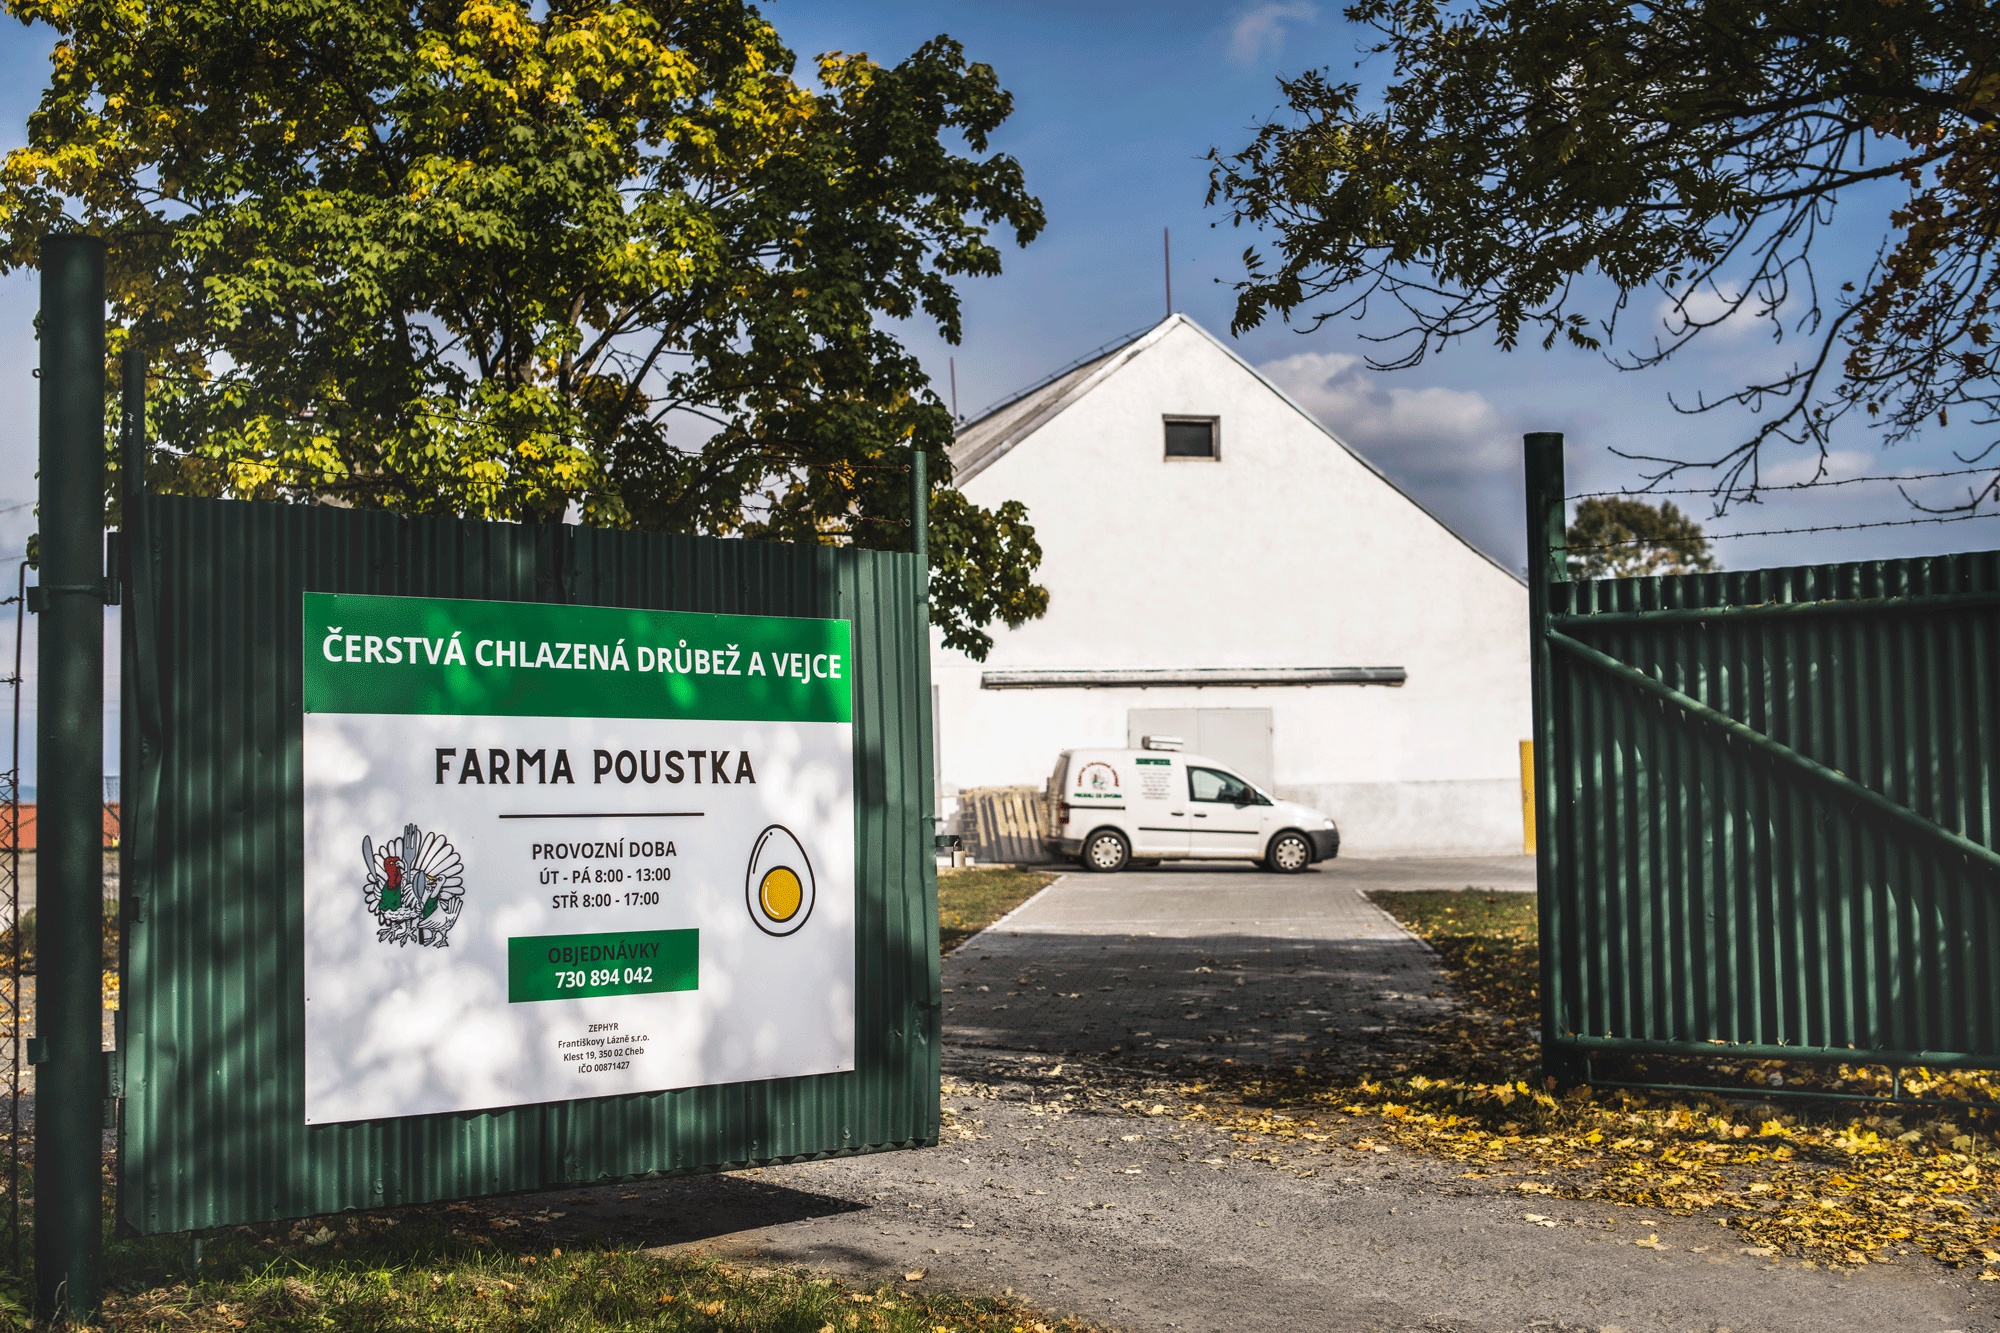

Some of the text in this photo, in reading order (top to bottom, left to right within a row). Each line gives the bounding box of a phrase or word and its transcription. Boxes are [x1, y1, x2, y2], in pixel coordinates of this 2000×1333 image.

[322, 625, 842, 684] ČERSTVÁ CHLAZENÁ DRŮBEŽ A VEJCE
[435, 747, 757, 785] FARMA POUSTKA
[532, 837, 677, 860] PROVOZNÍ DOBA
[539, 867, 560, 885] ÚT
[572, 866, 592, 884] PÁ
[594, 868, 624, 884] 8:00
[635, 867, 671, 882] 13:00
[552, 890, 579, 909] STŘ
[582, 893, 612, 908] 8:00
[623, 891, 660, 906] 17:00
[547, 939, 661, 967] OBJEDNÁVKY
[555, 966, 653, 989] 730 894 042
[588, 1022, 619, 1033] ZEPHYR
[558, 1034, 650, 1049] Františkovy Lázně s.r.o.
[563, 1046, 645, 1062] Klest 19, 350 02 Cheb
[578, 1060, 630, 1074] IČO 00871427
